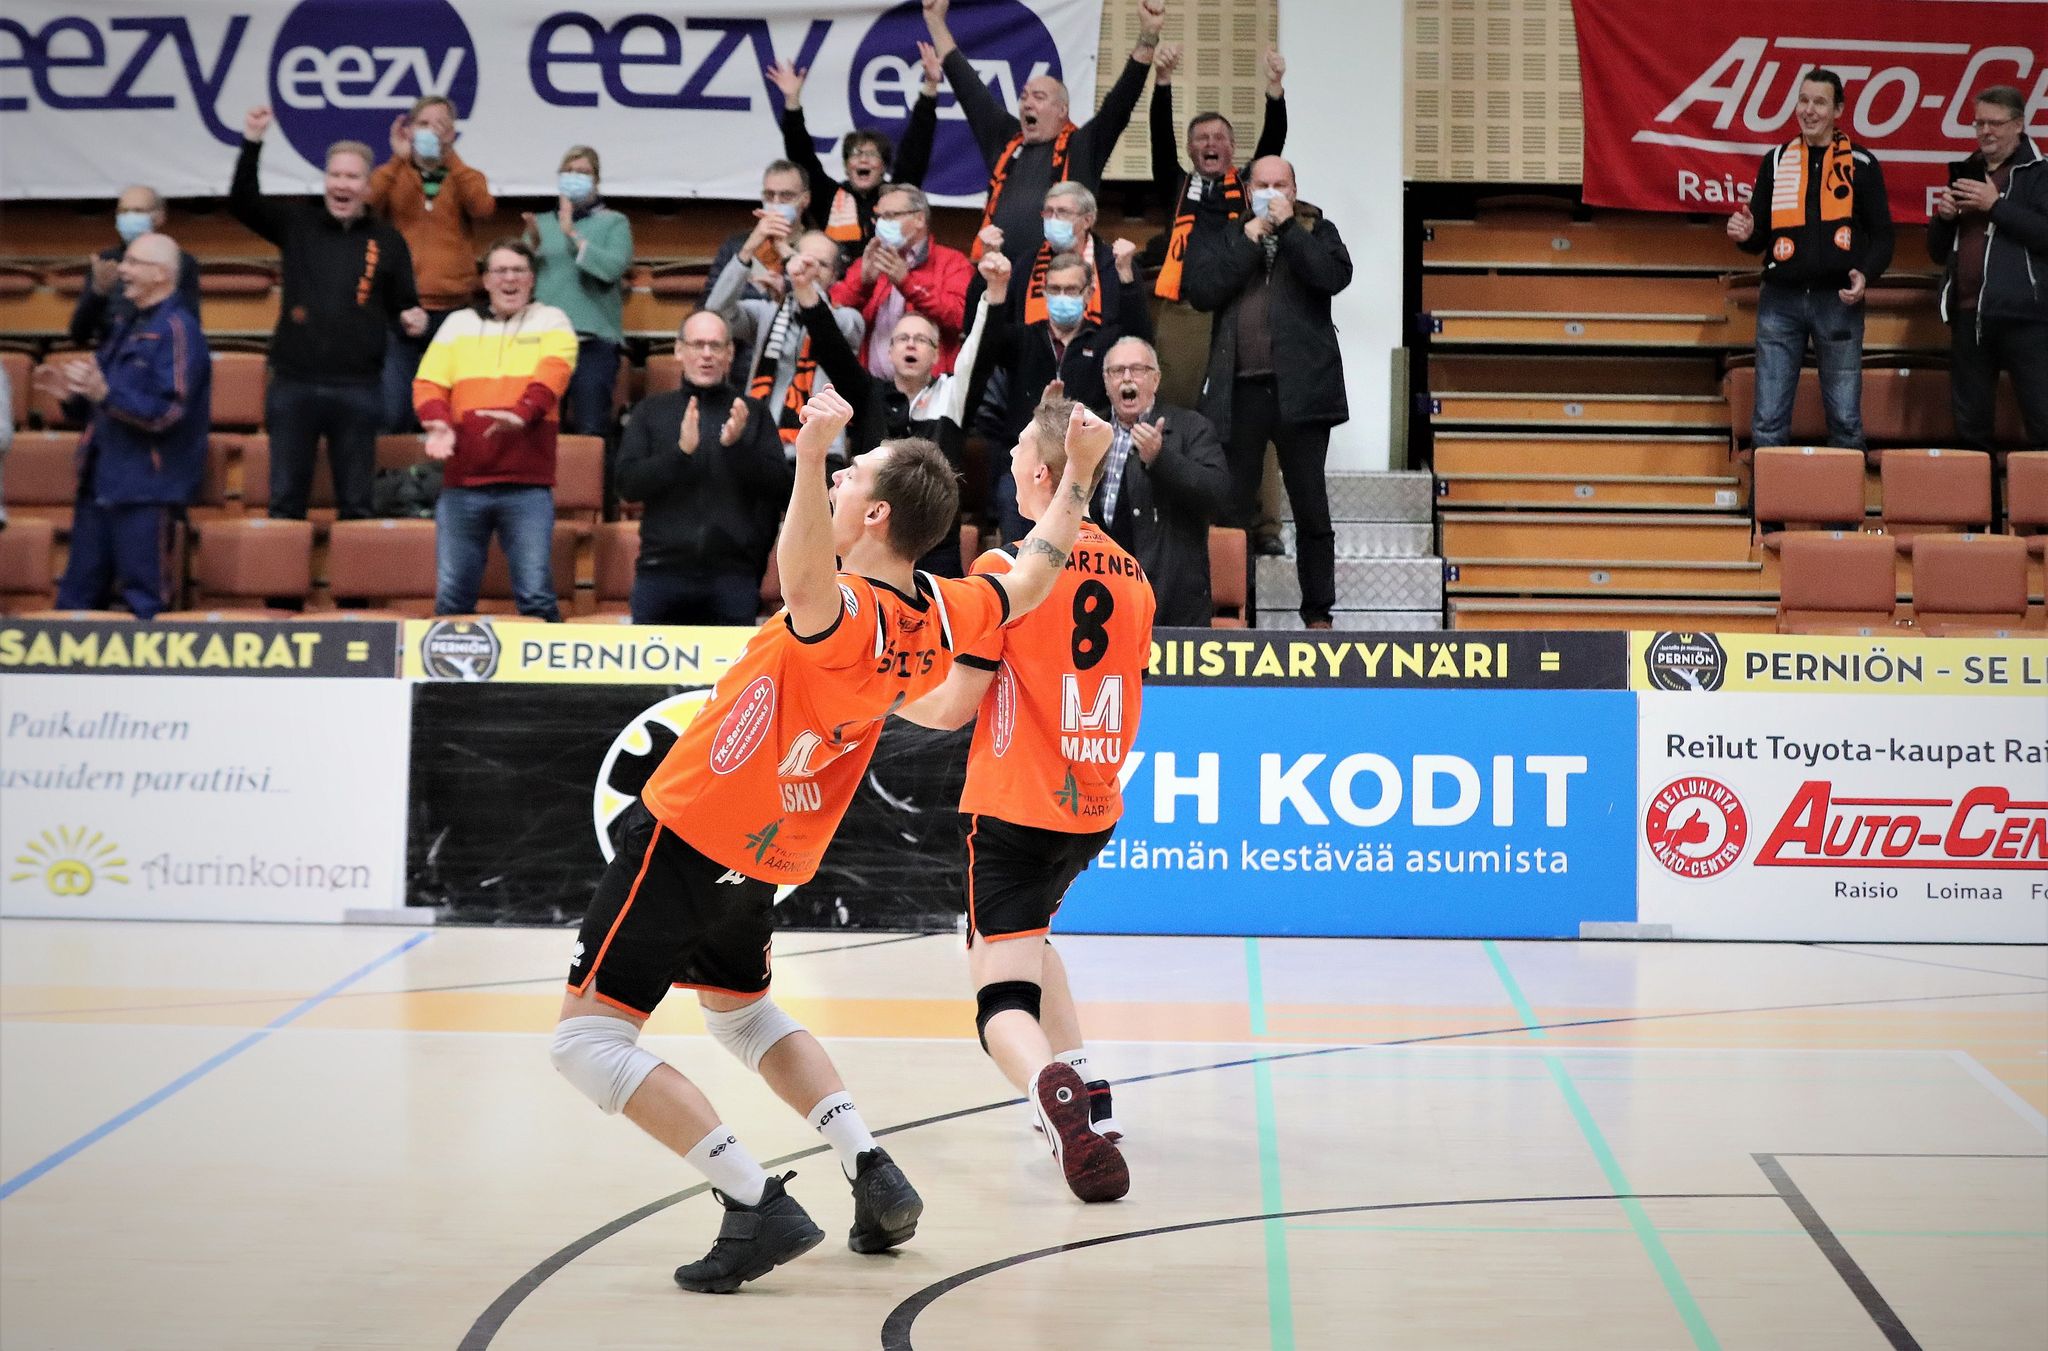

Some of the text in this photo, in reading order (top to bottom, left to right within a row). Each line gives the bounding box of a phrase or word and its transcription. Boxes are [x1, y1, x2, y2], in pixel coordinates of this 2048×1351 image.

[277, 44, 465, 110] eezy
[528, 12, 833, 153] eezy
[1678, 169, 1757, 204] Rais
[1072, 579, 1114, 670] 8
[0, 628, 321, 668] SAMAKKARAT
[521, 637, 700, 671] PERNIÖN
[1658, 652, 1714, 665] PERNIÖN
[1745, 646, 1923, 683] PERNIÖN
[1964, 656, 2008, 684] SE
[2023, 656, 2048, 684] L
[6, 711, 191, 742] Paikallinen
[1666, 733, 1758, 760] Reilut
[1767, 735, 1996, 768] Toyota-kaupat
[1259, 751, 1588, 828] KODIT
[1655, 780, 1738, 814] REILUHINTA
[141, 852, 371, 891] Aurinkoinen
[1098, 838, 1569, 874] Elämän kestävää asumista
[1653, 841, 1740, 876] AUTO-CENTER
[1834, 880, 1899, 899] Raisio
[1926, 882, 2003, 900] Loimaa
